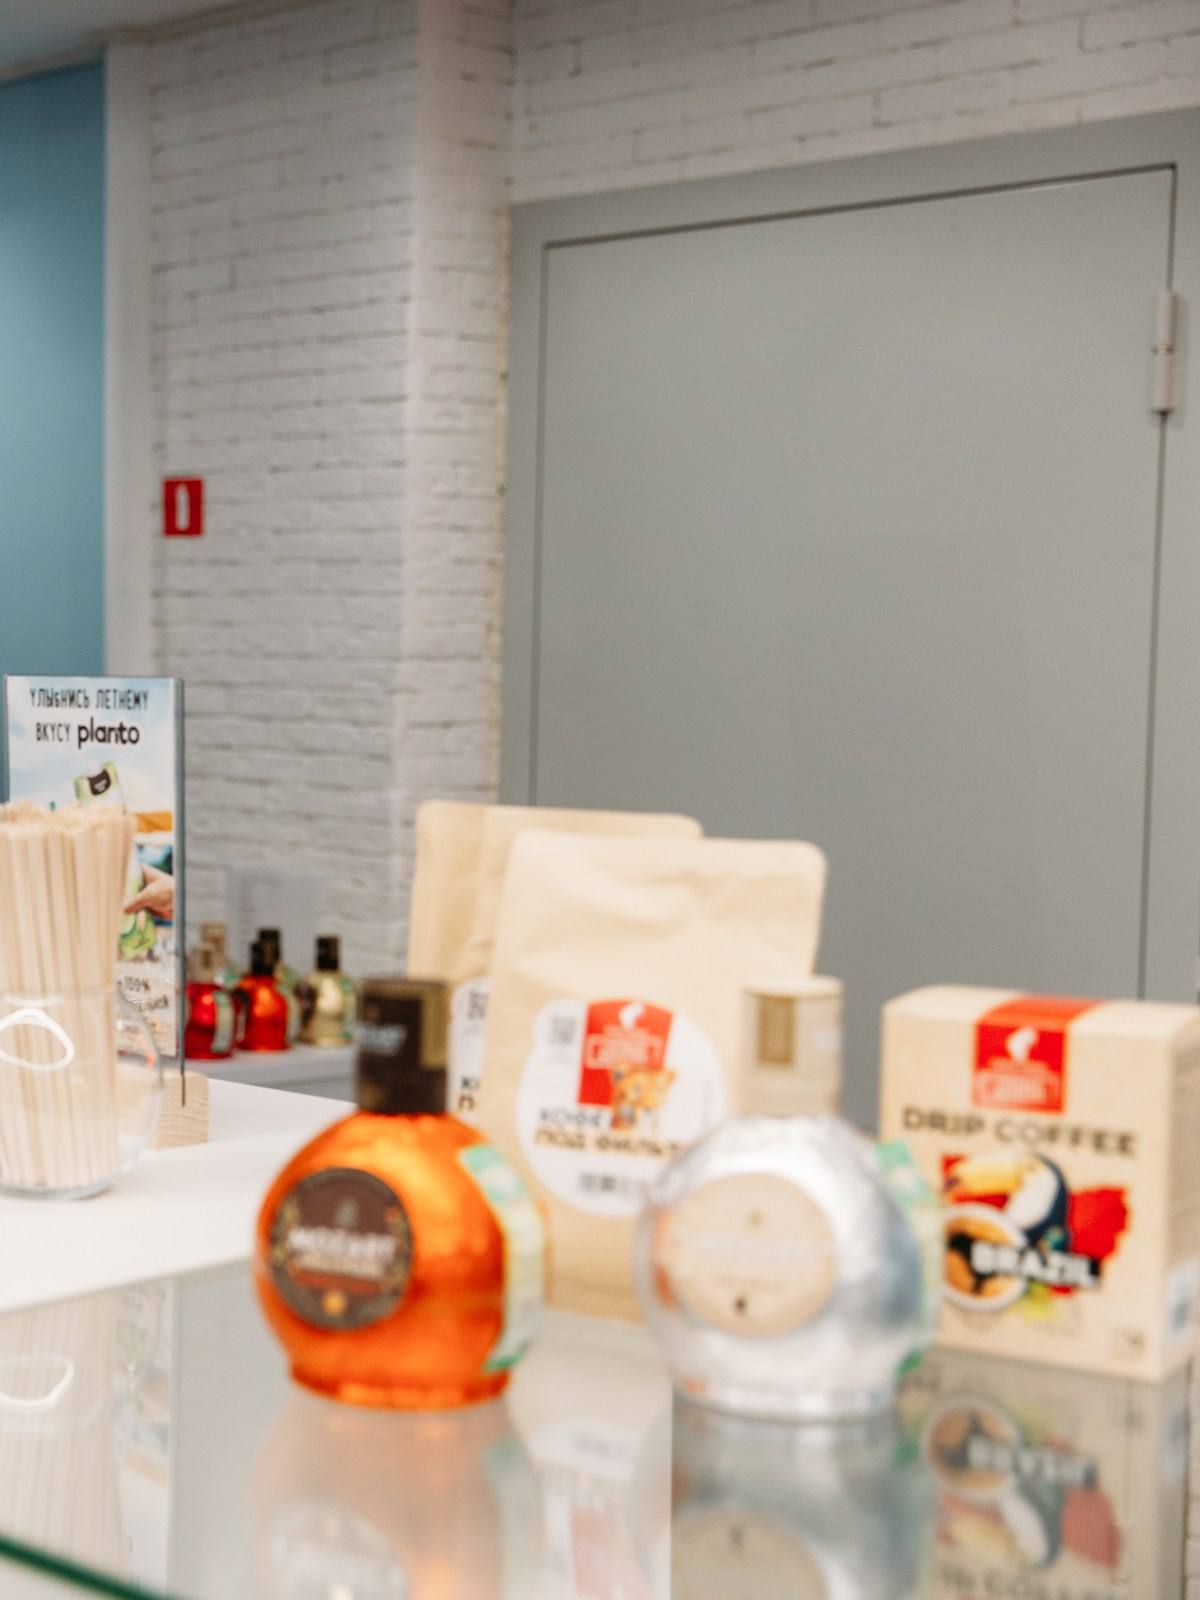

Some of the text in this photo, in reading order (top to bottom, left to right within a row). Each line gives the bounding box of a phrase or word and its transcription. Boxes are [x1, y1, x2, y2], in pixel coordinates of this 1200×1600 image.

[30, 688, 149, 710] УЛЫБНИСЬ ЛЕТНЕМУ
[36, 716, 140, 750] ВКУСУ planto
[540, 1109, 602, 1127] КОФЕ
[902, 1106, 1137, 1157] DRIP COFFEE
[535, 1127, 587, 1150] ПОД
[970, 1240, 1101, 1289] BRAZIL
